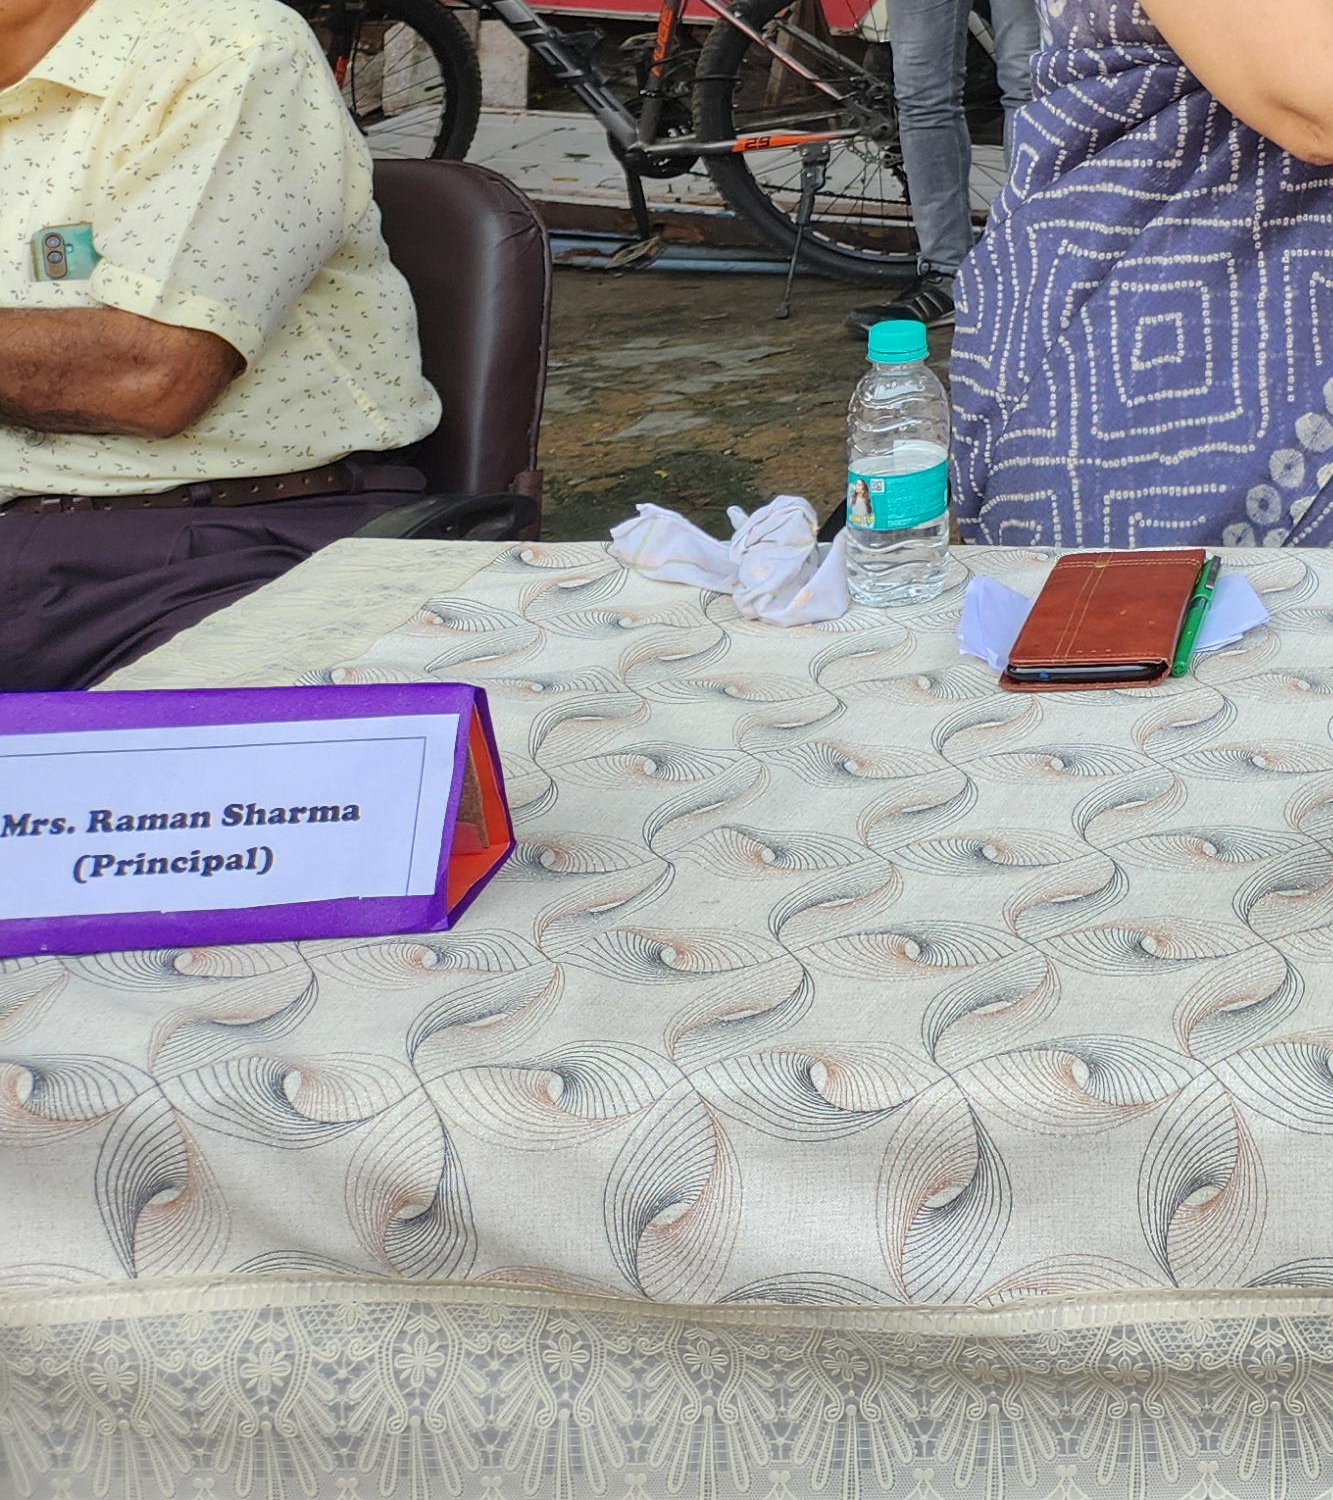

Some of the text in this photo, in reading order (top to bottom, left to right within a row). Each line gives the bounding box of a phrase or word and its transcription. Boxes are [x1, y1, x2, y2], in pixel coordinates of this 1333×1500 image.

[744, 135, 771, 150] 29
[0, 802, 360, 838] Mrs. Raman Sharma
[73, 845, 273, 884] (Principal)
